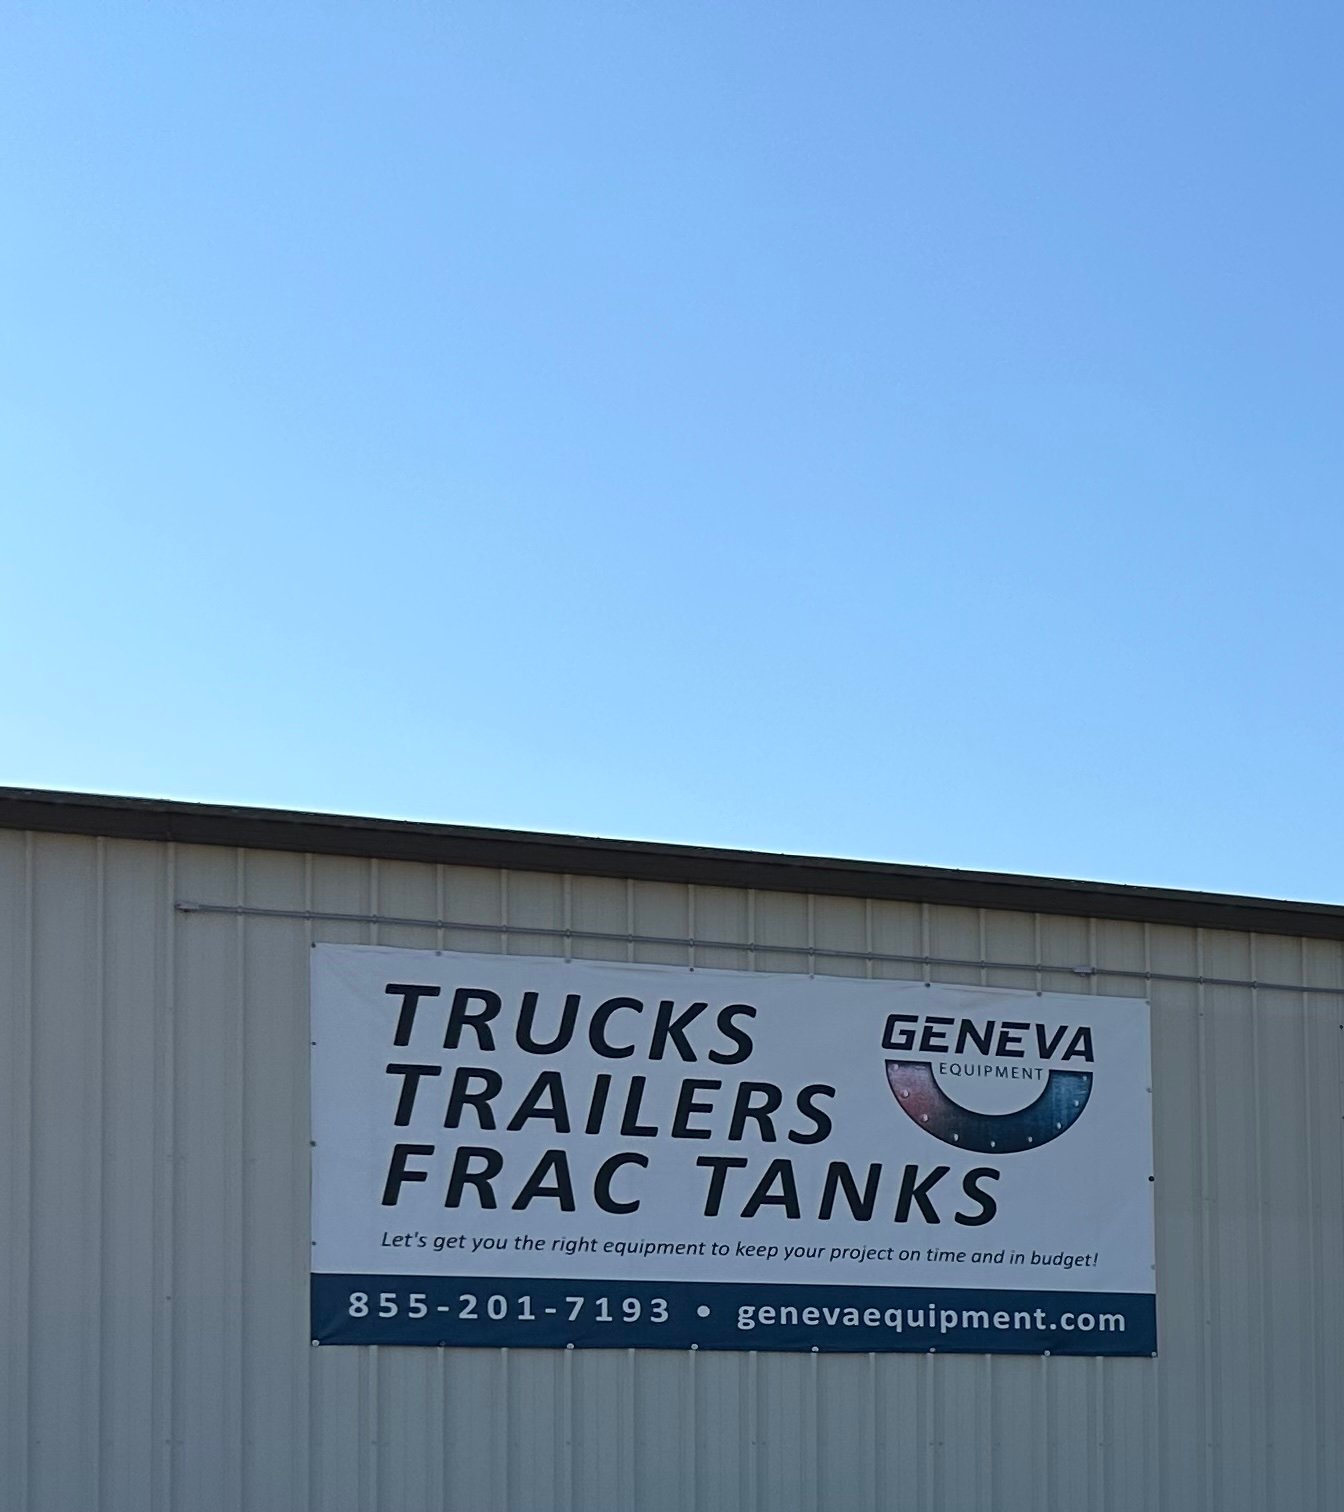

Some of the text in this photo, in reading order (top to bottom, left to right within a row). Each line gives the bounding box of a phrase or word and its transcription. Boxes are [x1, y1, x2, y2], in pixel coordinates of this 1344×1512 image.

[385, 983, 757, 1065] TRUCKS
[881, 1013, 1095, 1063] GENEVA
[939, 1062, 1044, 1081] EQUIPMENT
[385, 1063, 836, 1145] TRAILERS
[381, 1143, 1001, 1227] FRAC TANKS
[381, 1231, 1100, 1270] Let's get you the right equipment to keep your project on time and in budget!
[348, 1292, 1126, 1334] 855-201-7193 genevaequipment.com
